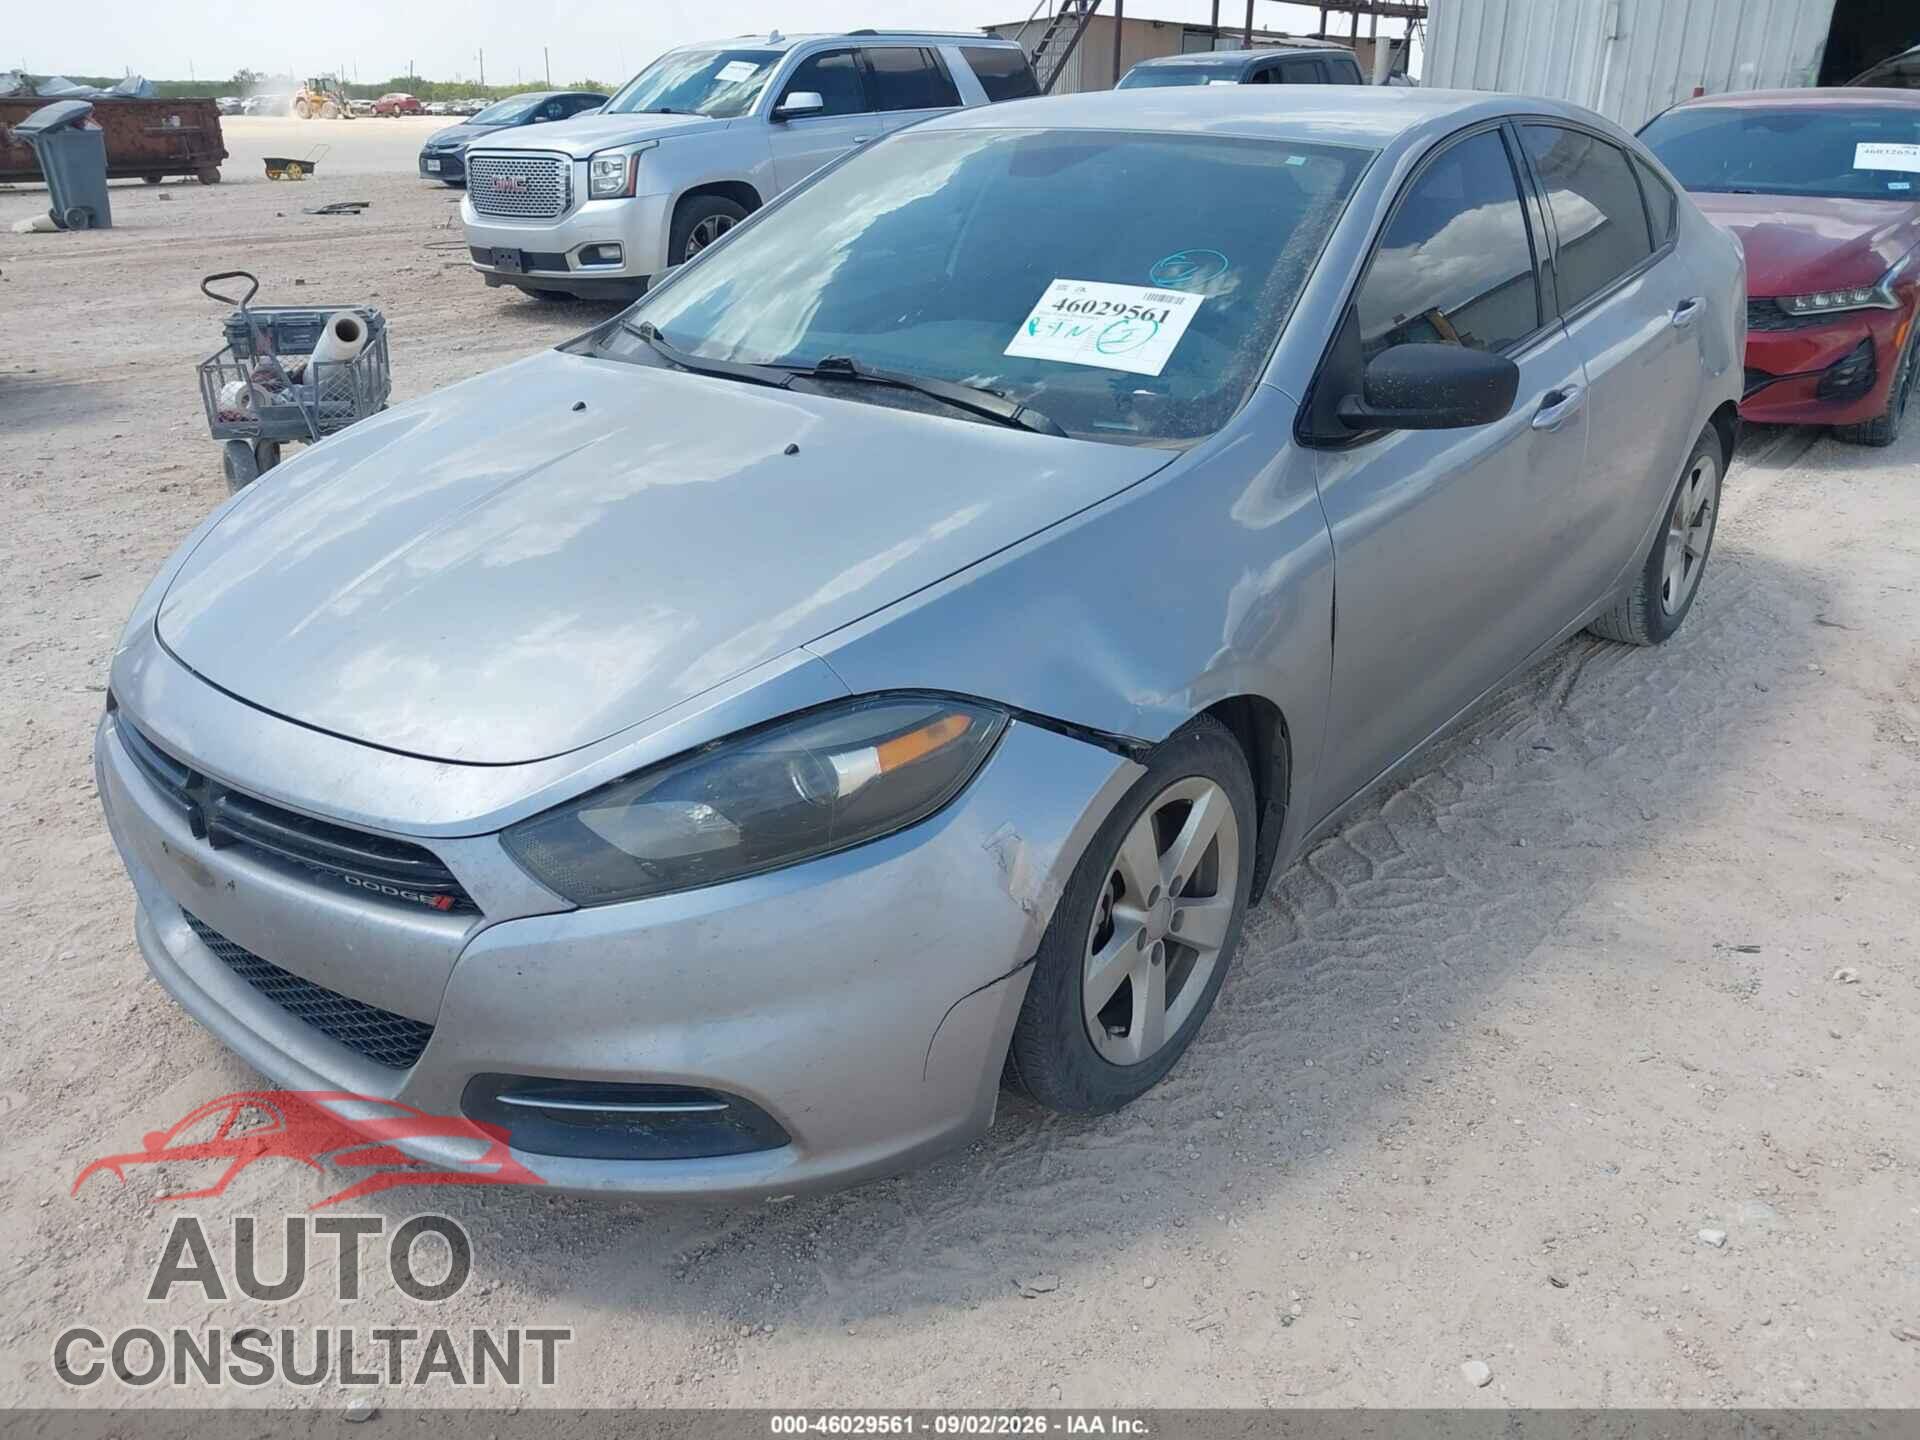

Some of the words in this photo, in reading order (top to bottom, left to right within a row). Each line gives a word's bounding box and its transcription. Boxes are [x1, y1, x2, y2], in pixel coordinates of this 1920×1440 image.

[490, 175, 528, 192] GMC
[1051, 297, 1171, 324] 46029561
[344, 875, 434, 905] DODGE
